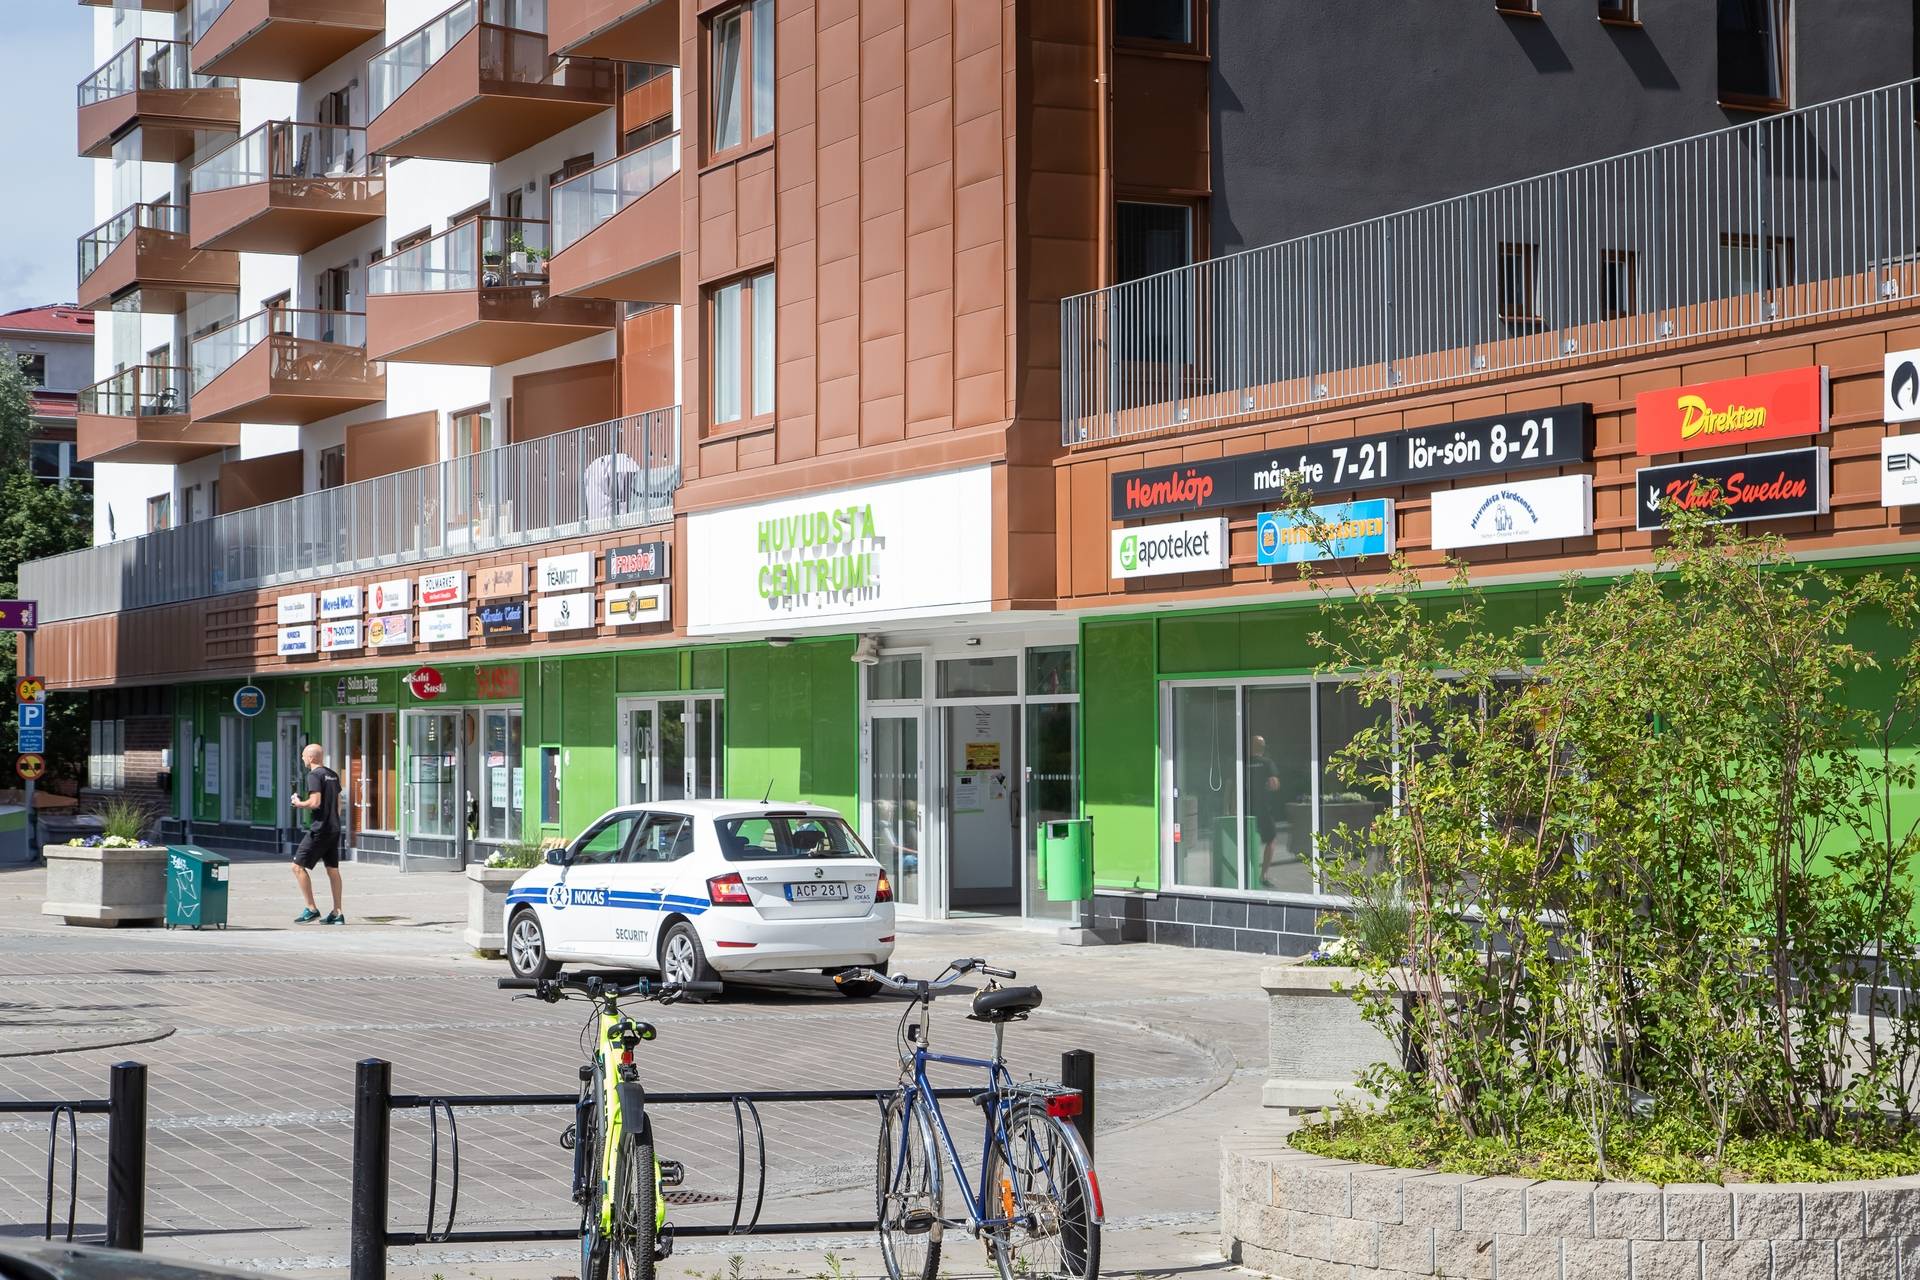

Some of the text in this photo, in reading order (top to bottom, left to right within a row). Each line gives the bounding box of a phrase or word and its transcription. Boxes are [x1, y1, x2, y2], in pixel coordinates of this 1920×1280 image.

[1678, 395, 1767, 440] Direkten
[1126, 469, 1213, 509] Hemköp
[1333, 442, 1387, 484] 7-21
[1408, 432, 1481, 469] lör-sön
[1490, 417, 1554, 464] 8-21
[1723, 472, 1806, 505] Sweden
[758, 503, 877, 553] HUVUDSTA
[1471, 493, 1500, 530] Huvudsta
[615, 549, 651, 575] FRISÖR
[1138, 529, 1210, 567] apoteket
[758, 552, 873, 599] CENTRUM!
[26, 708, 40, 726] P
[573, 890, 605, 905] NOKAS
[796, 884, 844, 898] ACP 281
[615, 928, 649, 943] SECURITY
